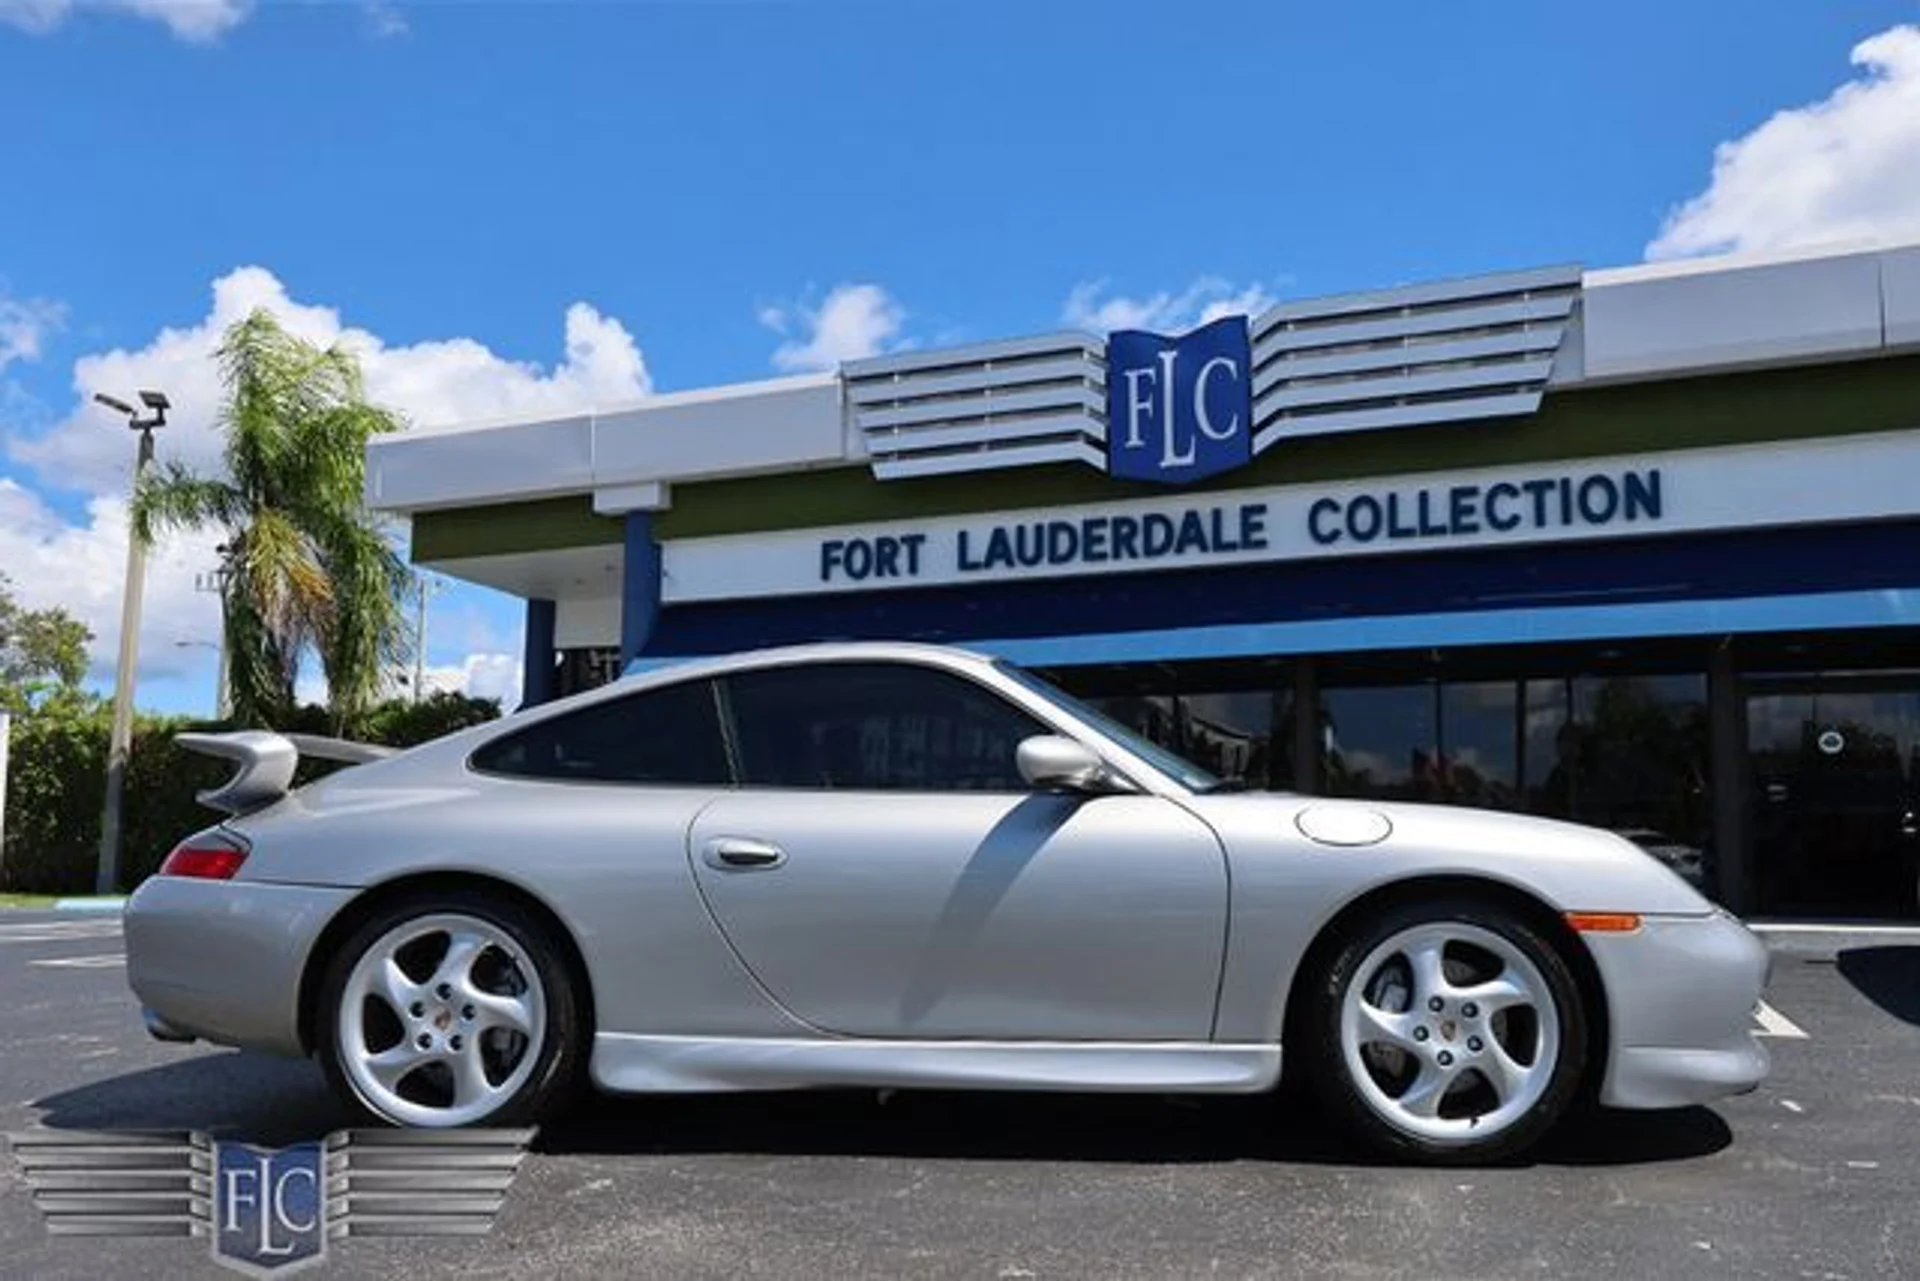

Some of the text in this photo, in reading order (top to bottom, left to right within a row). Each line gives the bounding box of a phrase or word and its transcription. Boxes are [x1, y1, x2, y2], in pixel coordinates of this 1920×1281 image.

[1123, 350, 1239, 469] FLC
[820, 470, 1662, 582] FORT LAUDERDALE COLLECTION
